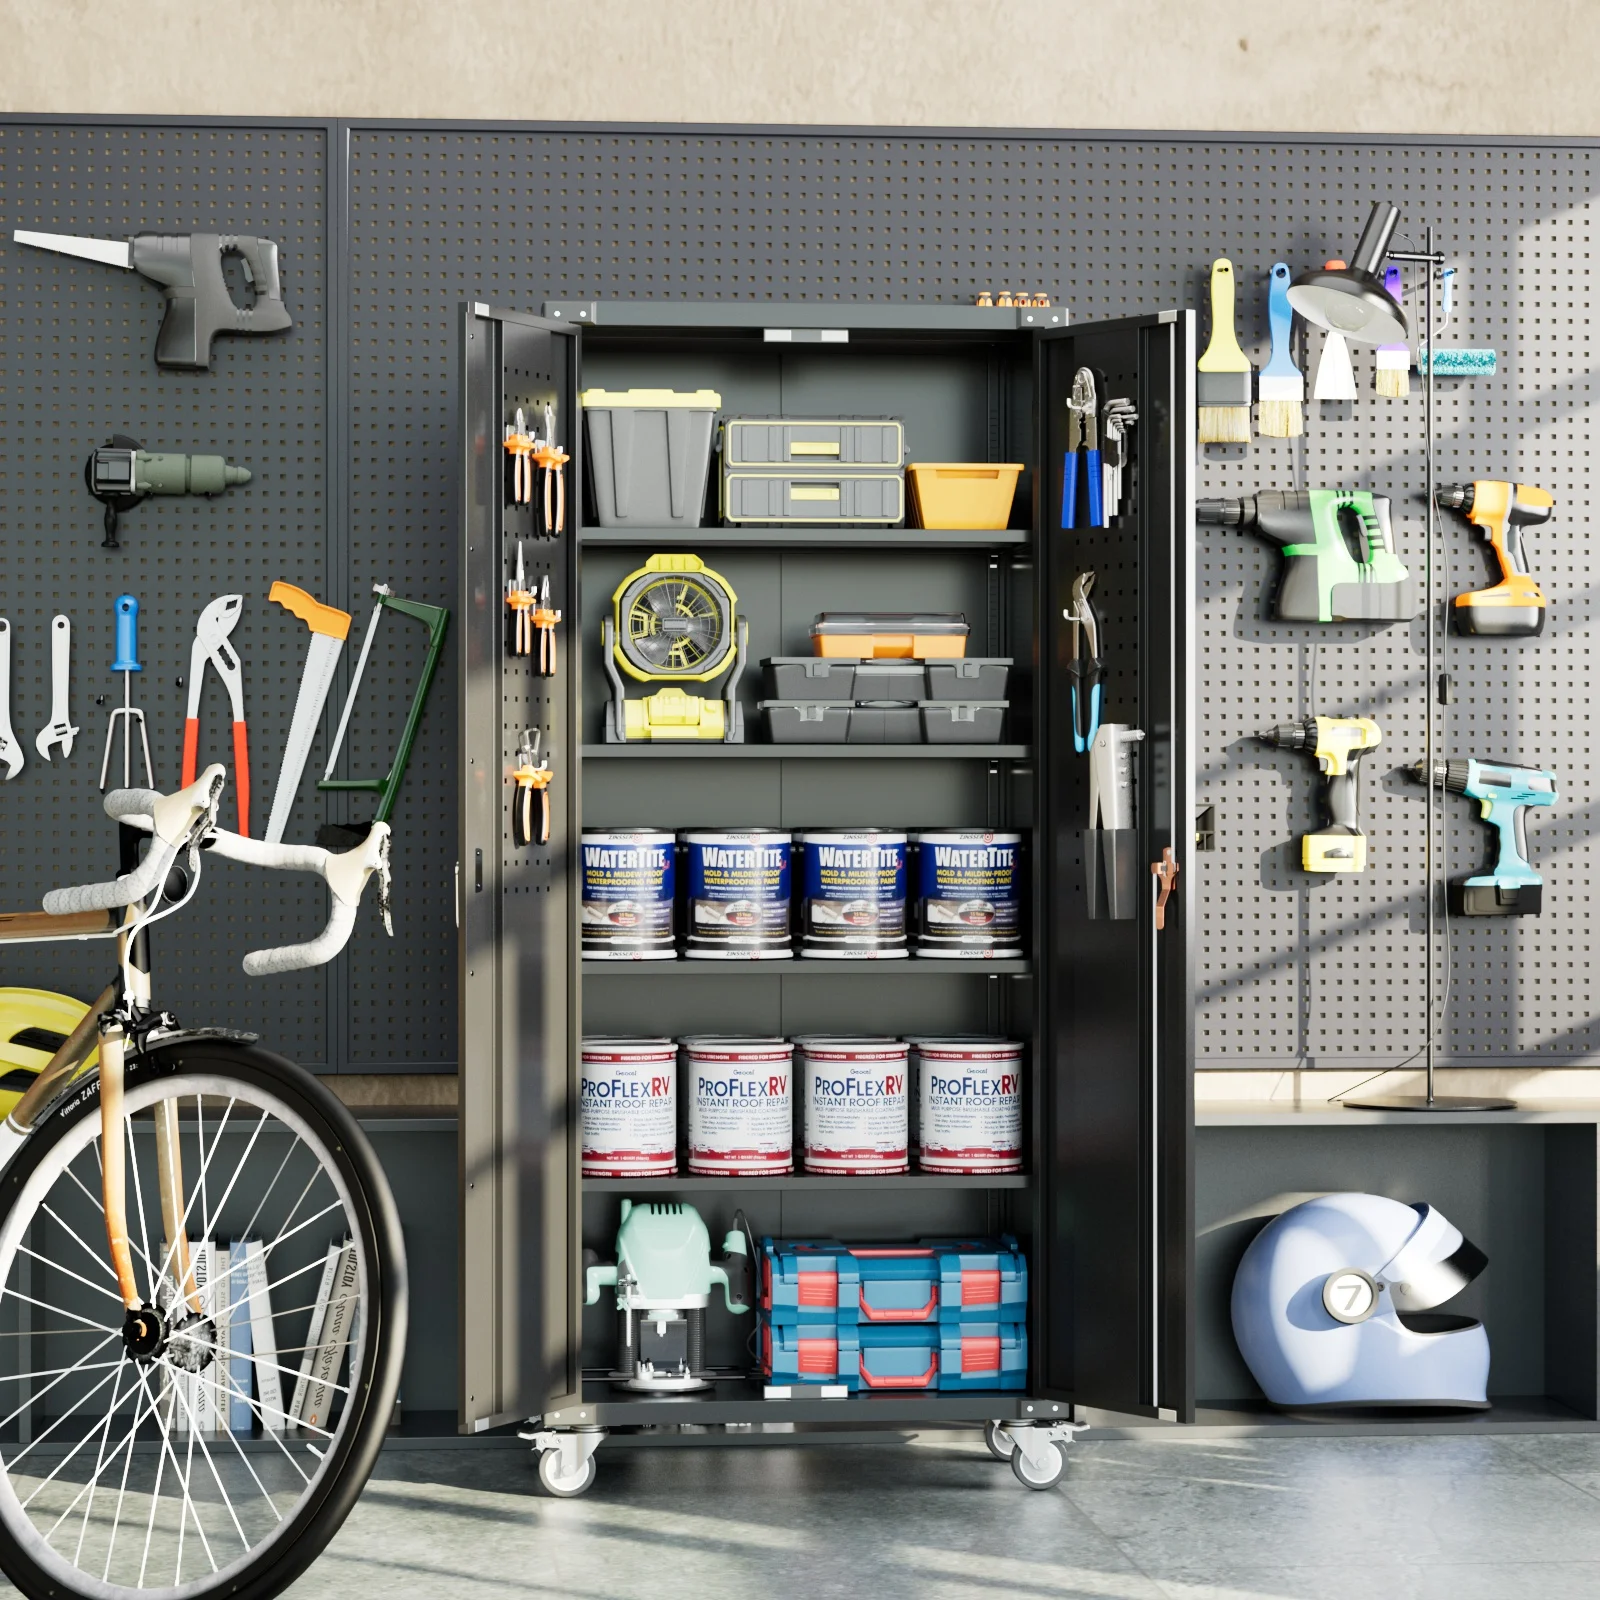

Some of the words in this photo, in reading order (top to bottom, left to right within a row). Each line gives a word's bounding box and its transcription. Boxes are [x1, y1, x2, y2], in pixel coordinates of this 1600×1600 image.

[582, 1098, 612, 1108] NSTANT
[615, 1099, 646, 1108] ROOF
[696, 1097, 729, 1107] INSTANT
[733, 1098, 764, 1108] ROOF
[813, 1096, 846, 1106] INSTANT
[850, 1098, 881, 1107] ROOF
[929, 1096, 962, 1106] INSTANT
[966, 1097, 997, 1106] ROOF
[60, 1098, 80, 1118] Vittoria
[1337, 1284, 1361, 1310] 7
